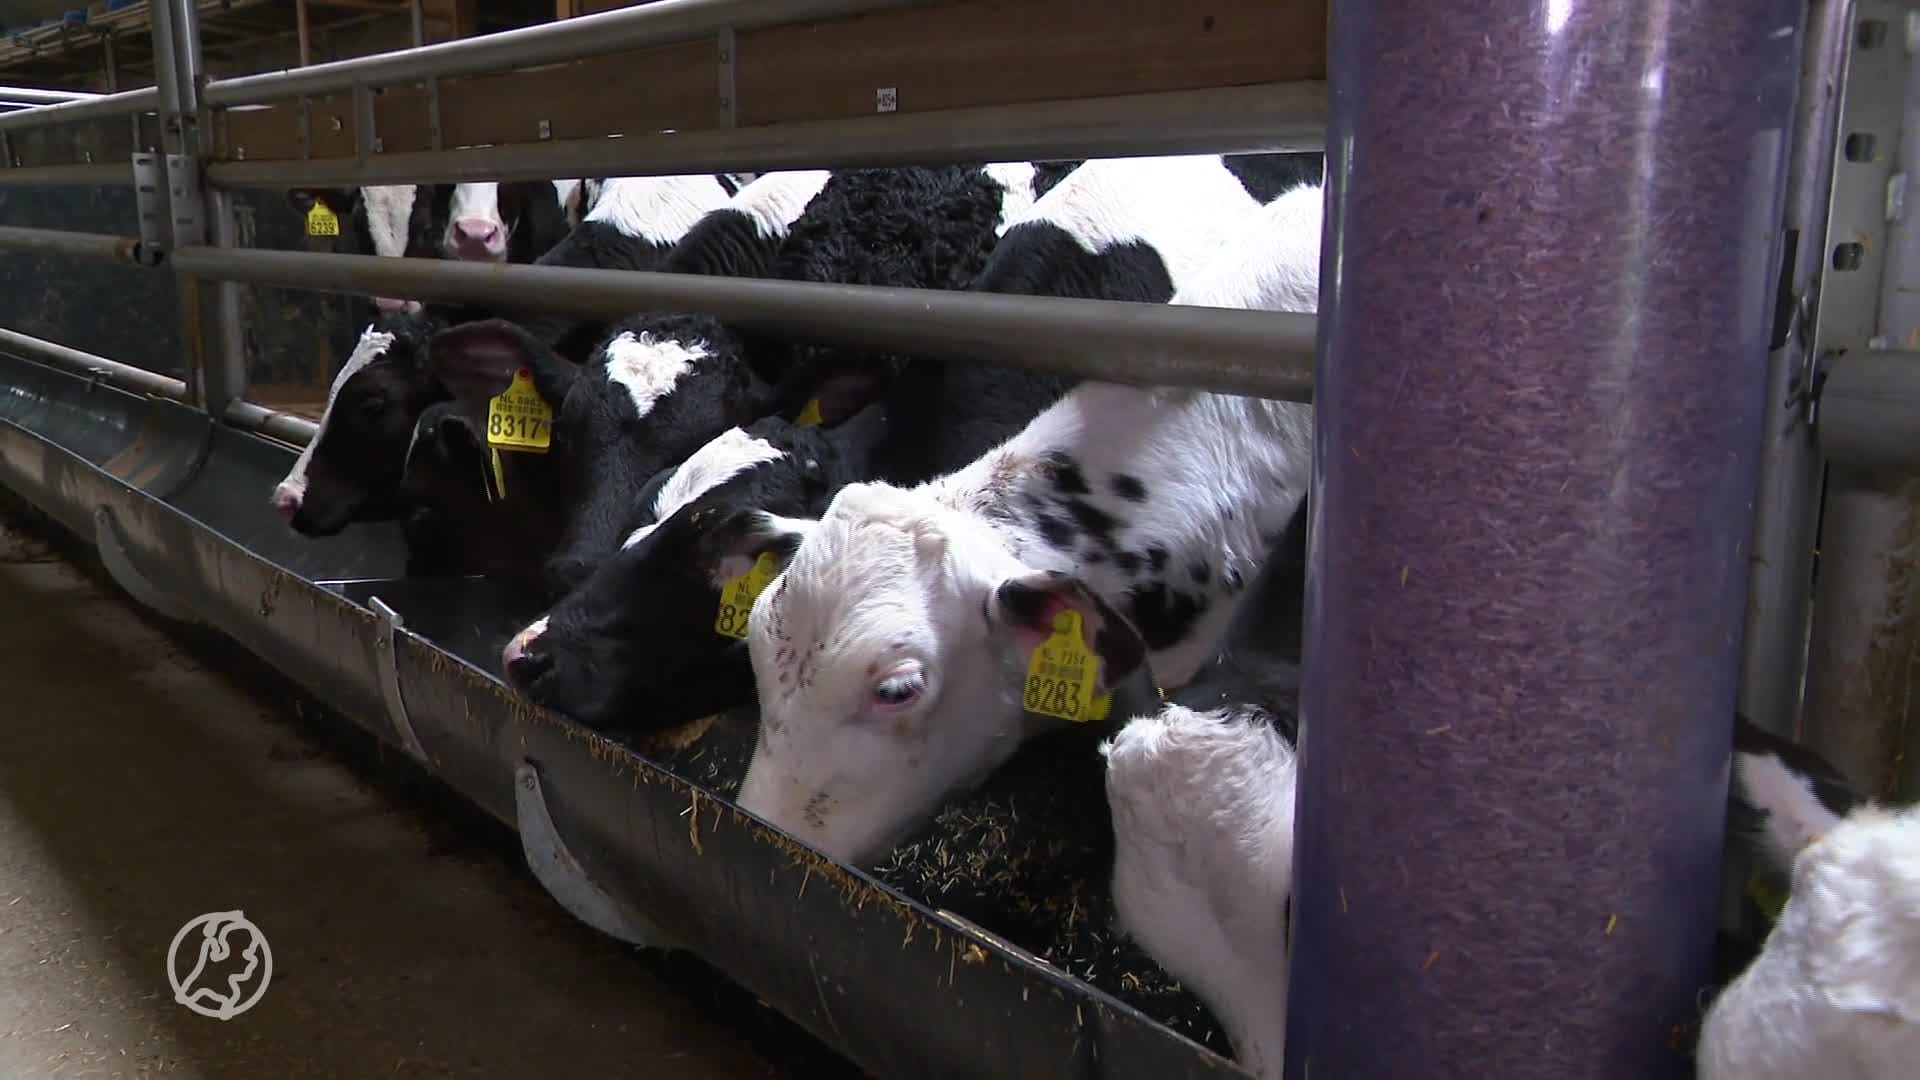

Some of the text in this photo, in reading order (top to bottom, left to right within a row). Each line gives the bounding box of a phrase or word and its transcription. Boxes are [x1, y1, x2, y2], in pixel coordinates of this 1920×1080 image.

[500, 393, 514, 404] NL
[490, 412, 543, 439] 8317
[1026, 674, 1081, 717] 8283
